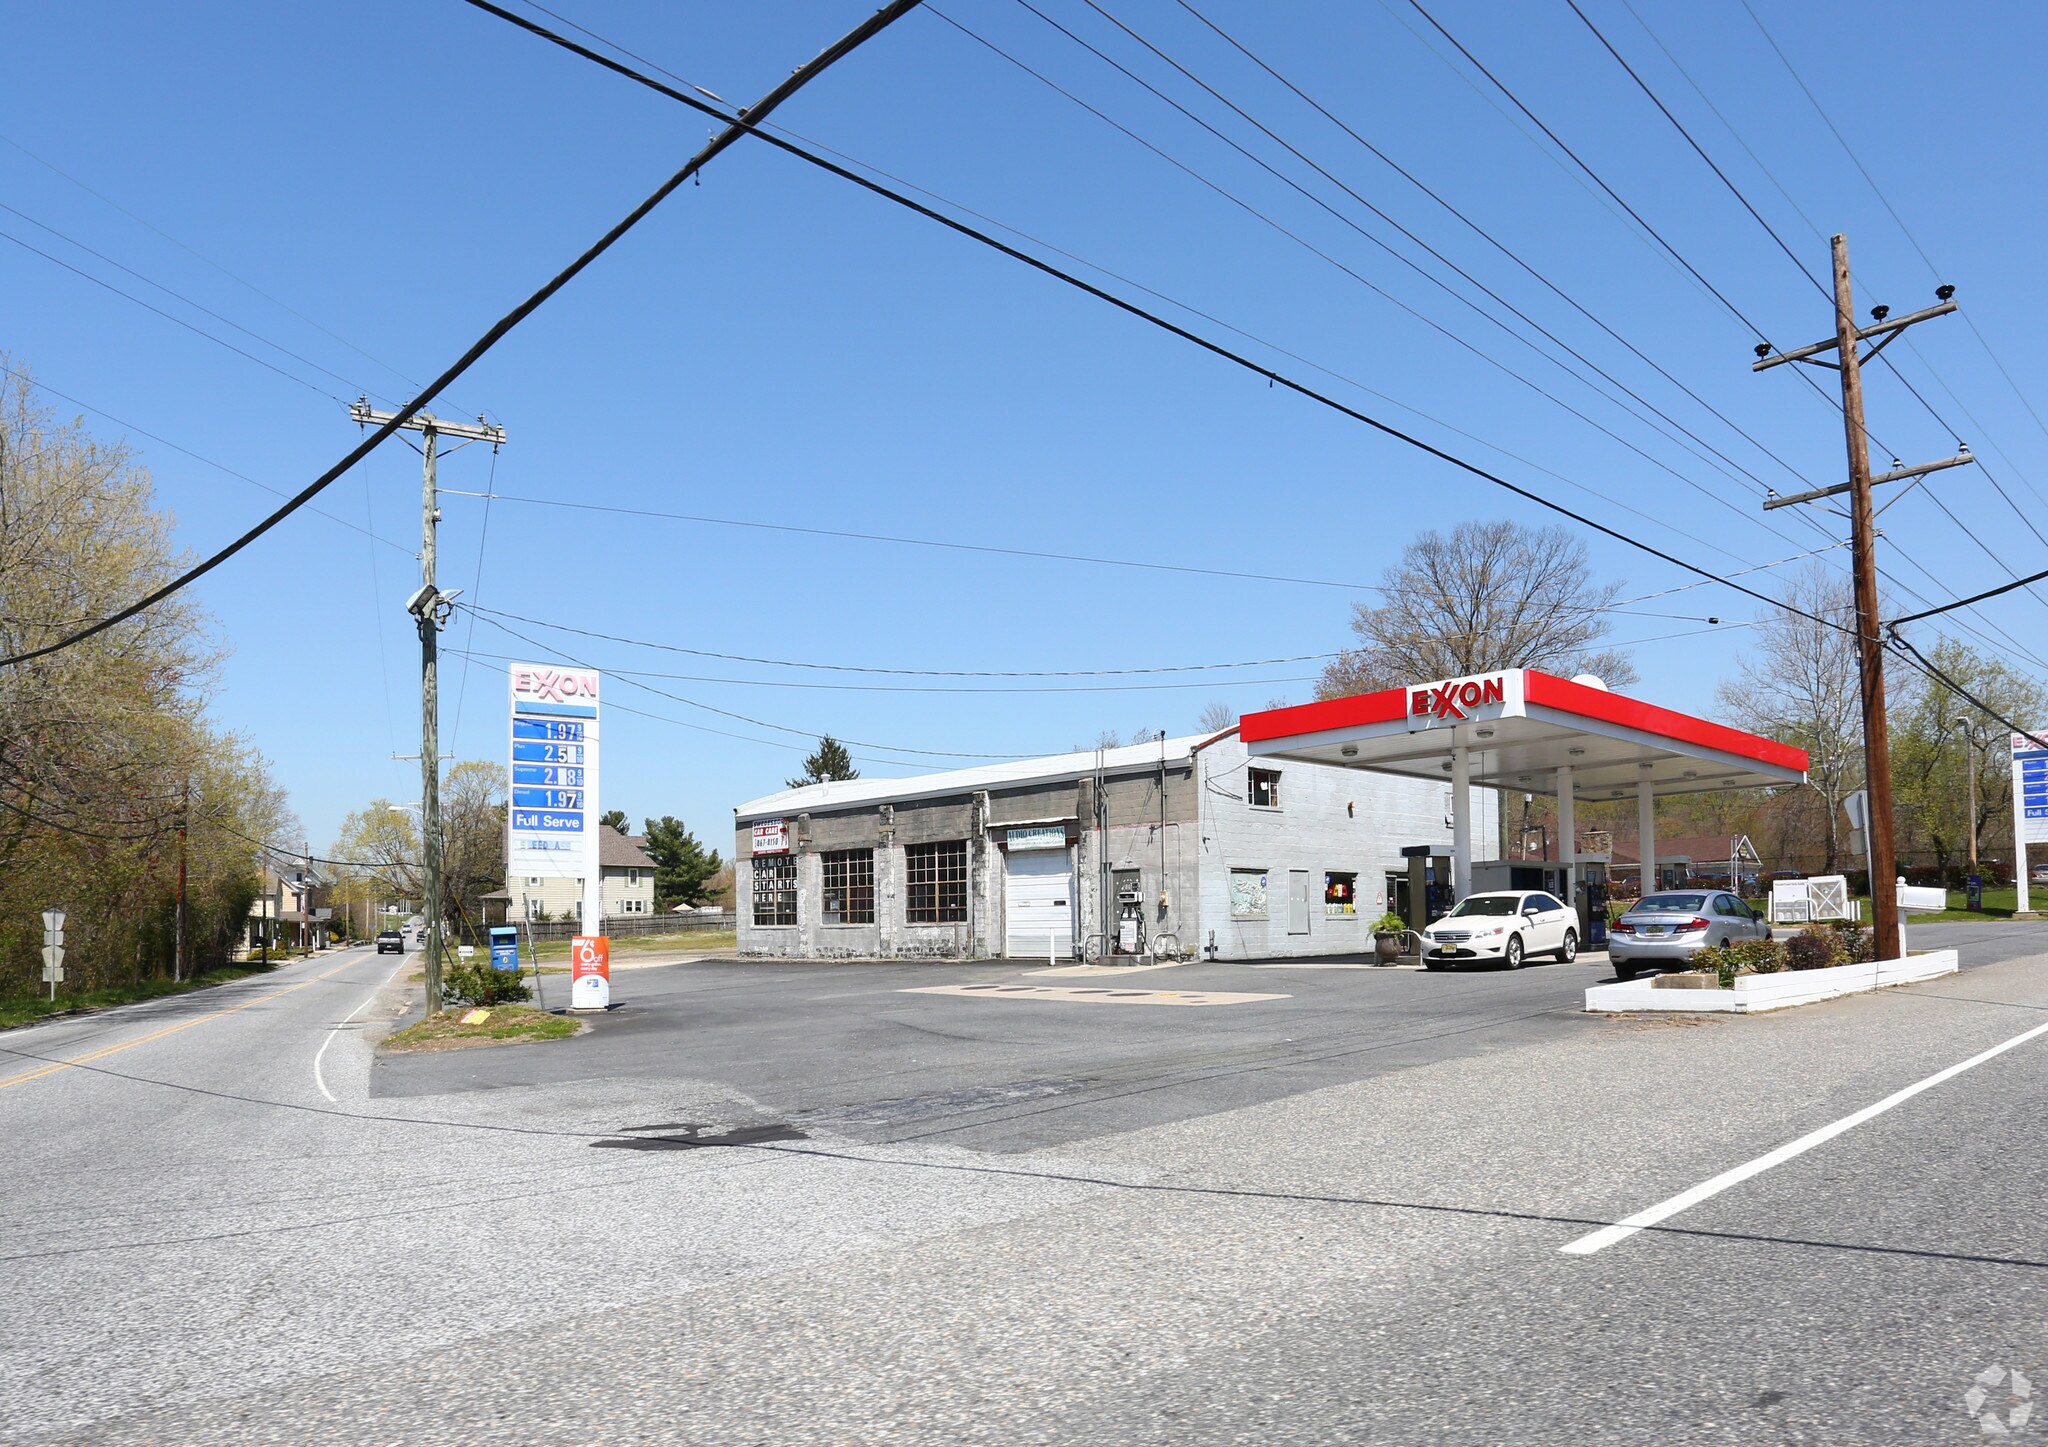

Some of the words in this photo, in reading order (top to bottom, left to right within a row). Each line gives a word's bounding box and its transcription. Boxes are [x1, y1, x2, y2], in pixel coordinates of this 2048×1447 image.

[515, 670, 597, 703] EXXON
[1412, 677, 1505, 719] EXXON
[2027, 809, 2042, 817] Full
[516, 814, 538, 827] Full
[543, 815, 580, 828] Serve
[754, 828, 764, 836] CAR
[765, 826, 778, 835] CARE
[754, 857, 798, 868] REMOTE
[754, 869, 774, 879] CAR
[754, 880, 798, 890] STARTS
[754, 893, 782, 902] HERE
